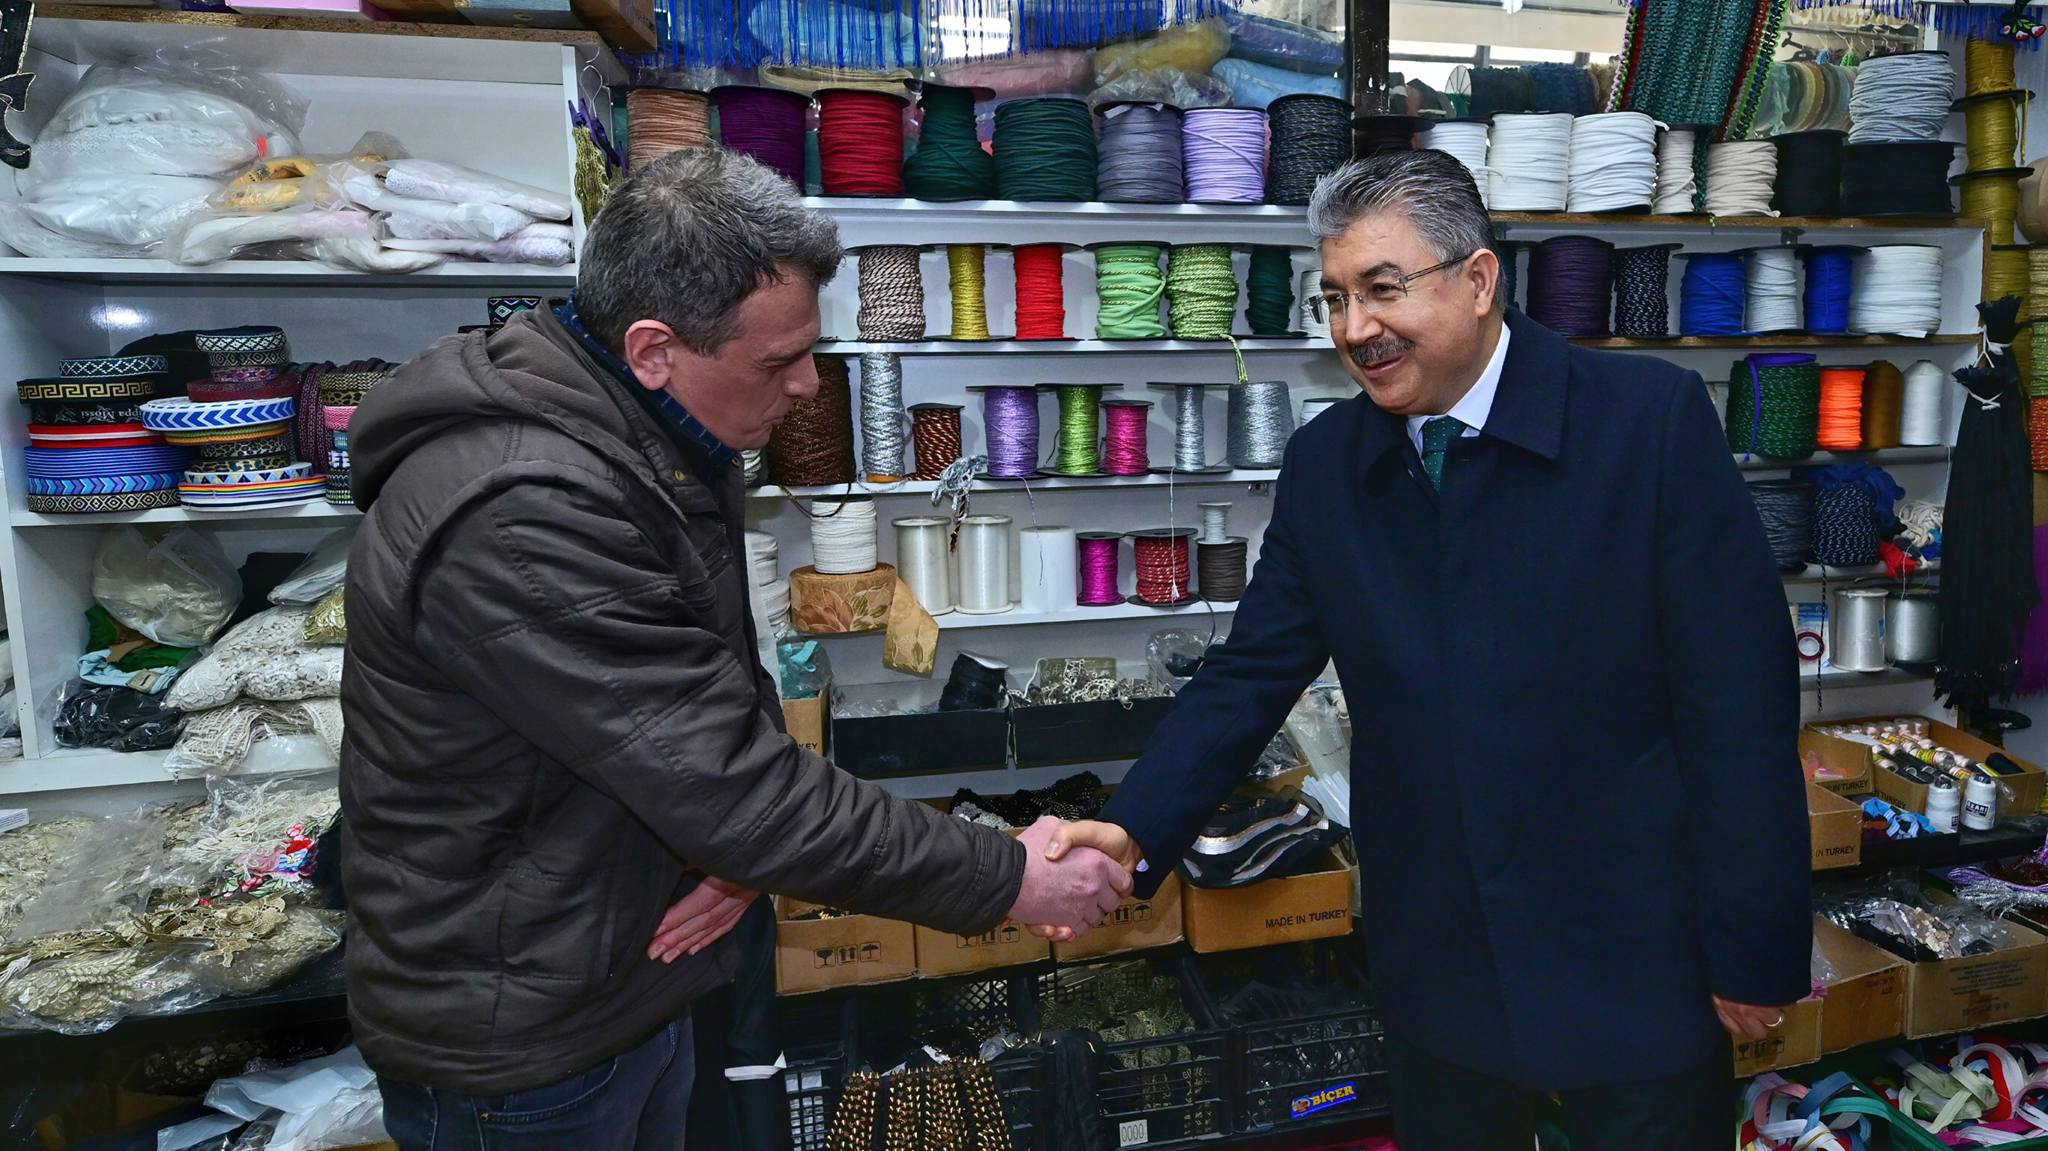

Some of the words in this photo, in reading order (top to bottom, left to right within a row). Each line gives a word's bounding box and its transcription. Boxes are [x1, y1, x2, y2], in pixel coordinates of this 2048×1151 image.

[81, 408, 115, 419] Mossi
[1825, 846, 1855, 856] TURKEY
[1265, 915, 1293, 928] MADE
[1296, 915, 1306, 924] IN
[1309, 908, 1348, 922] TURKEY
[1312, 1085, 1355, 1106] BİÇER
